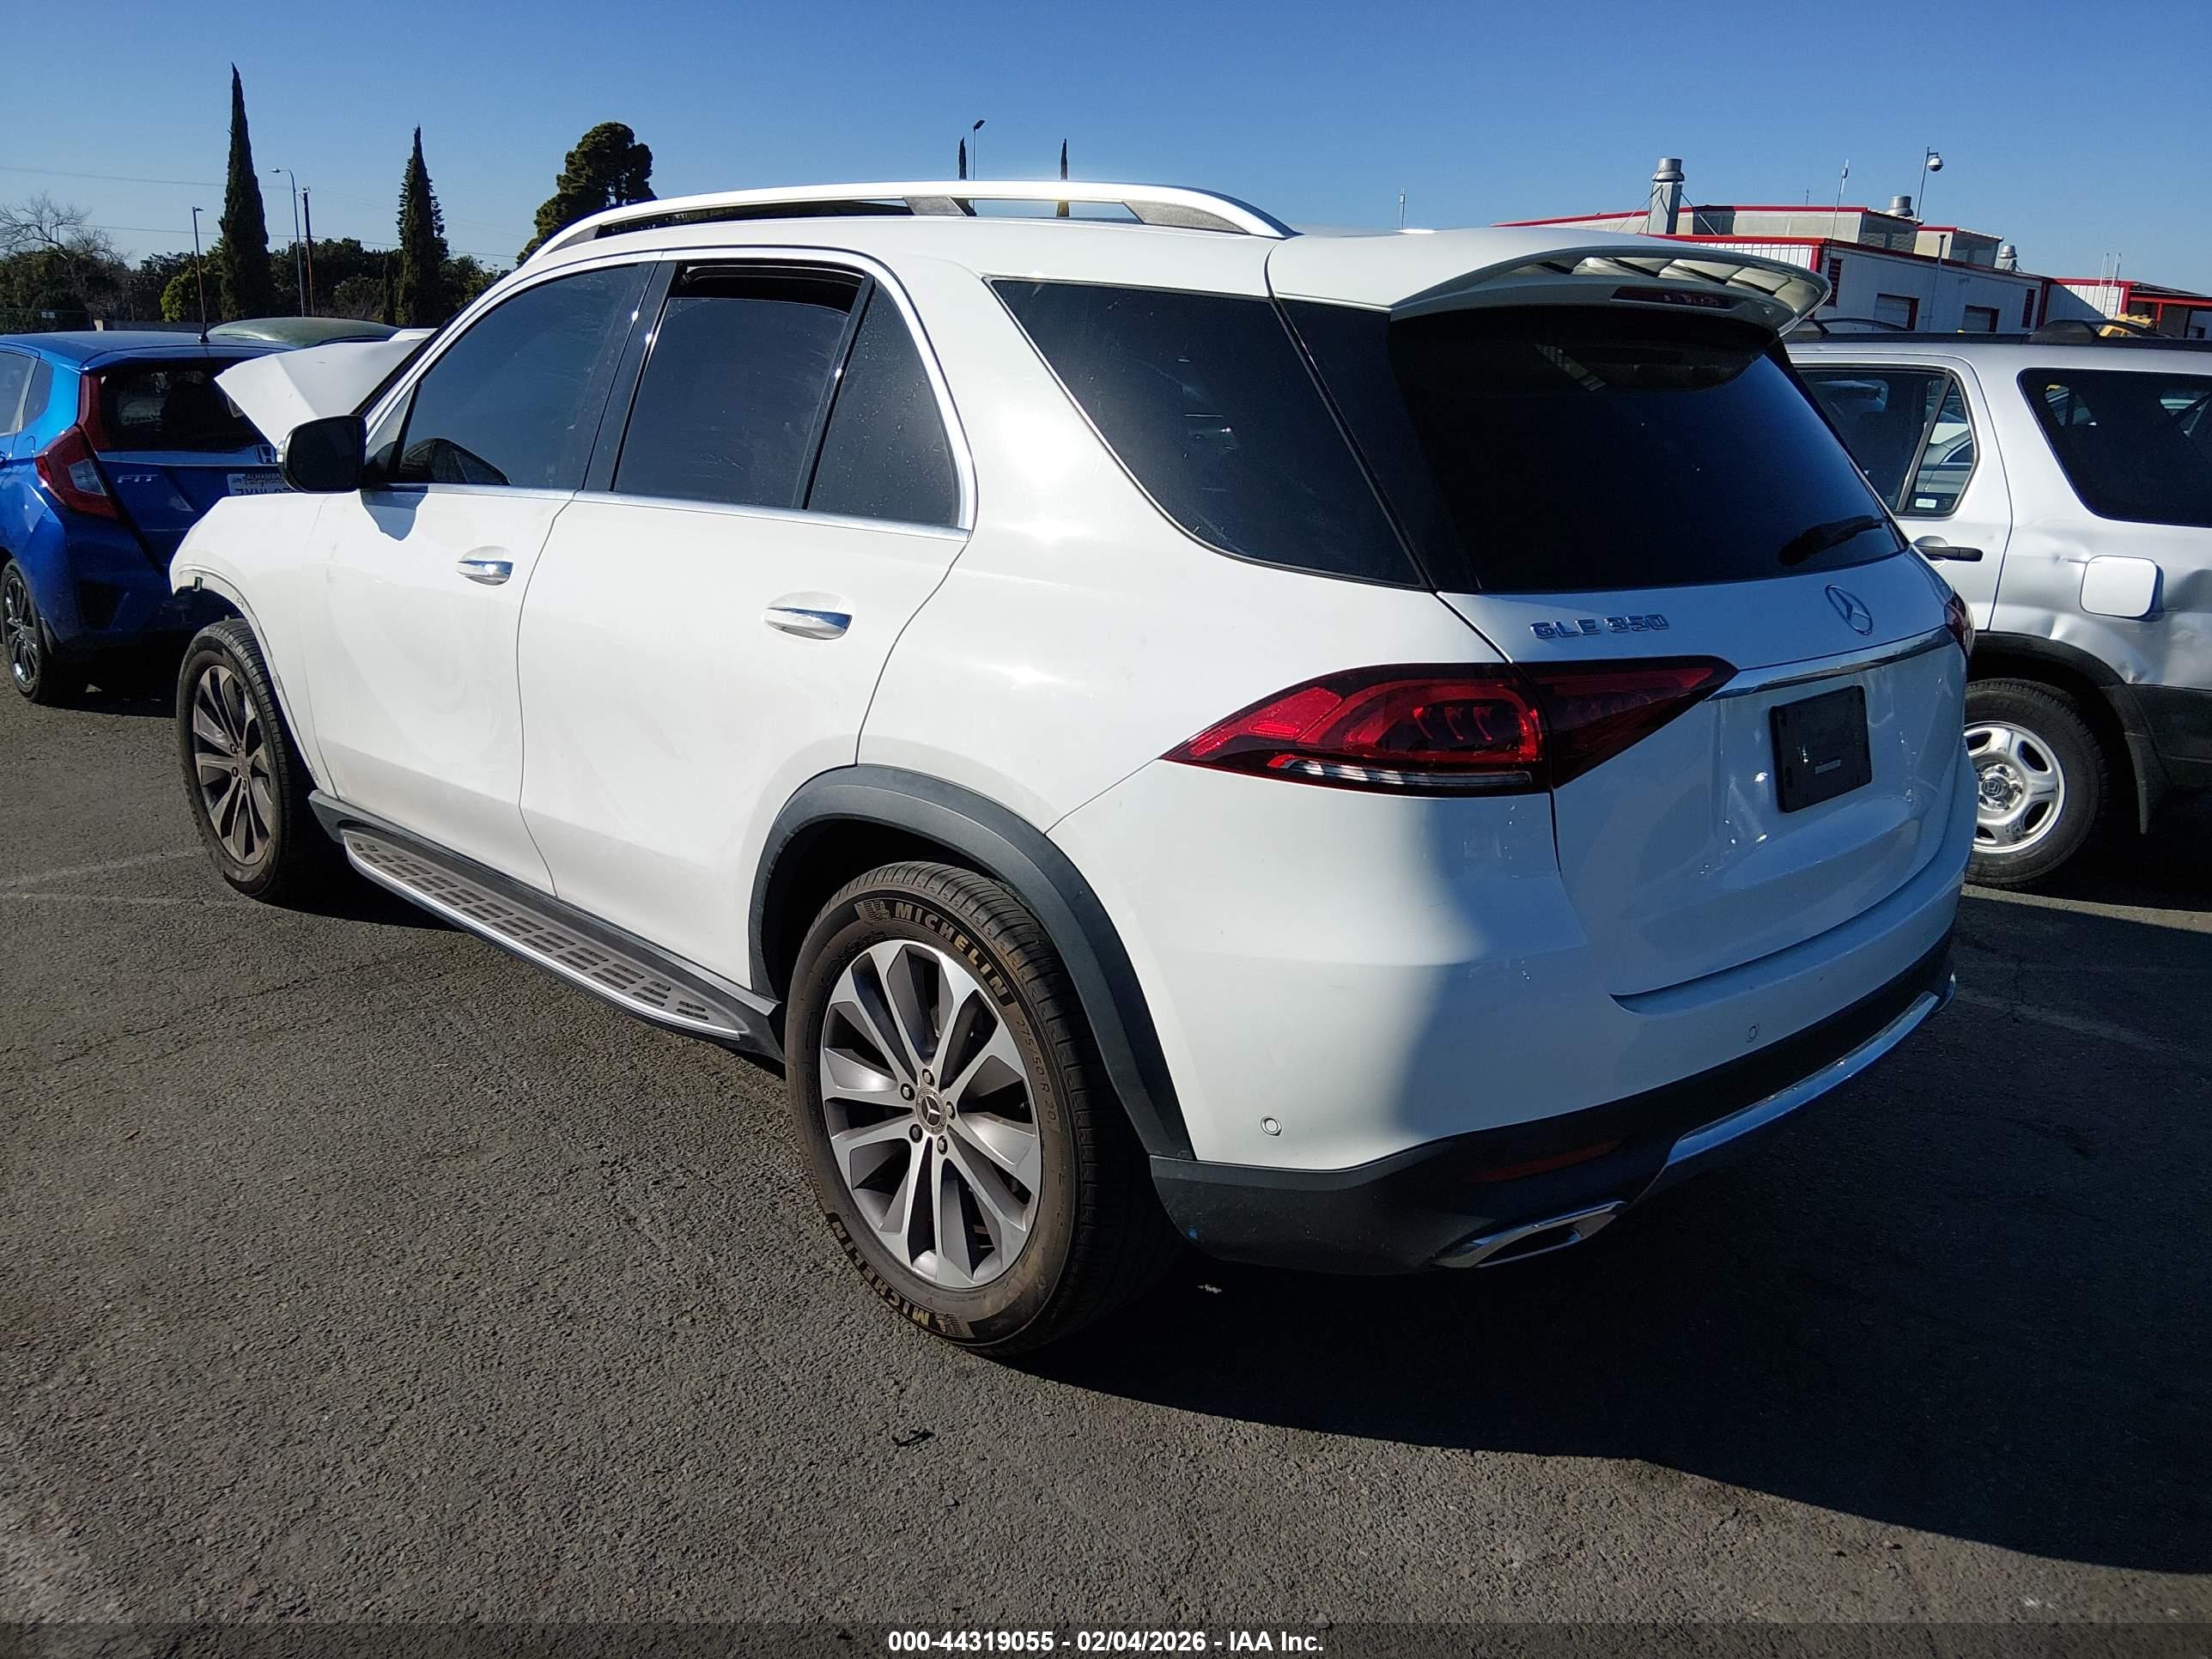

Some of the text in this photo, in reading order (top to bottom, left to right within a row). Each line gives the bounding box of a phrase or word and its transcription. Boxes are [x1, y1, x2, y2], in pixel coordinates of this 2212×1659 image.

[1529, 613, 1671, 640] GLE 350
[895, 902, 1010, 998] MICHELIN
[831, 1220, 930, 1327] MICHELIN
